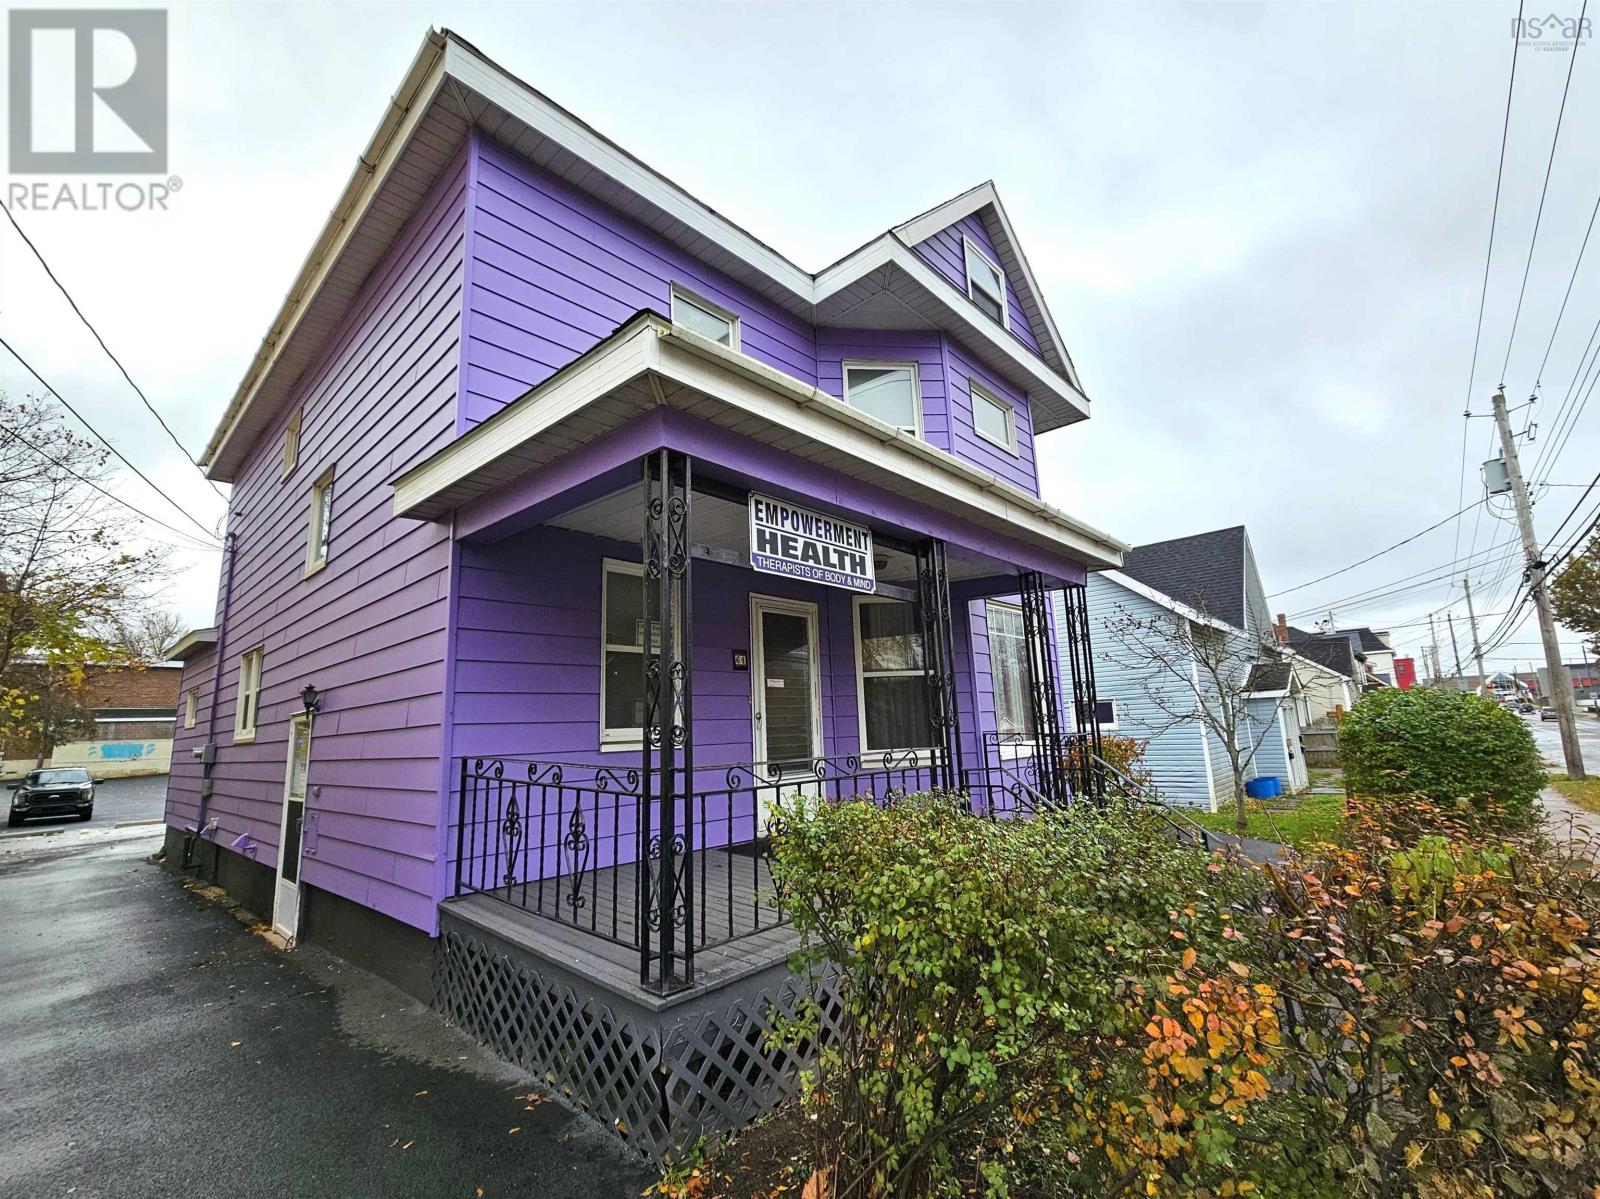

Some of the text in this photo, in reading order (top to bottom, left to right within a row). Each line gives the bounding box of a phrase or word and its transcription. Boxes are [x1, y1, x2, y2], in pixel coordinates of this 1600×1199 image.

[754, 498, 869, 552] EMPOWERMENT
[756, 527, 867, 577] HEALTH
[757, 556, 871, 590] THERAPISTS OF BODY & MIND
